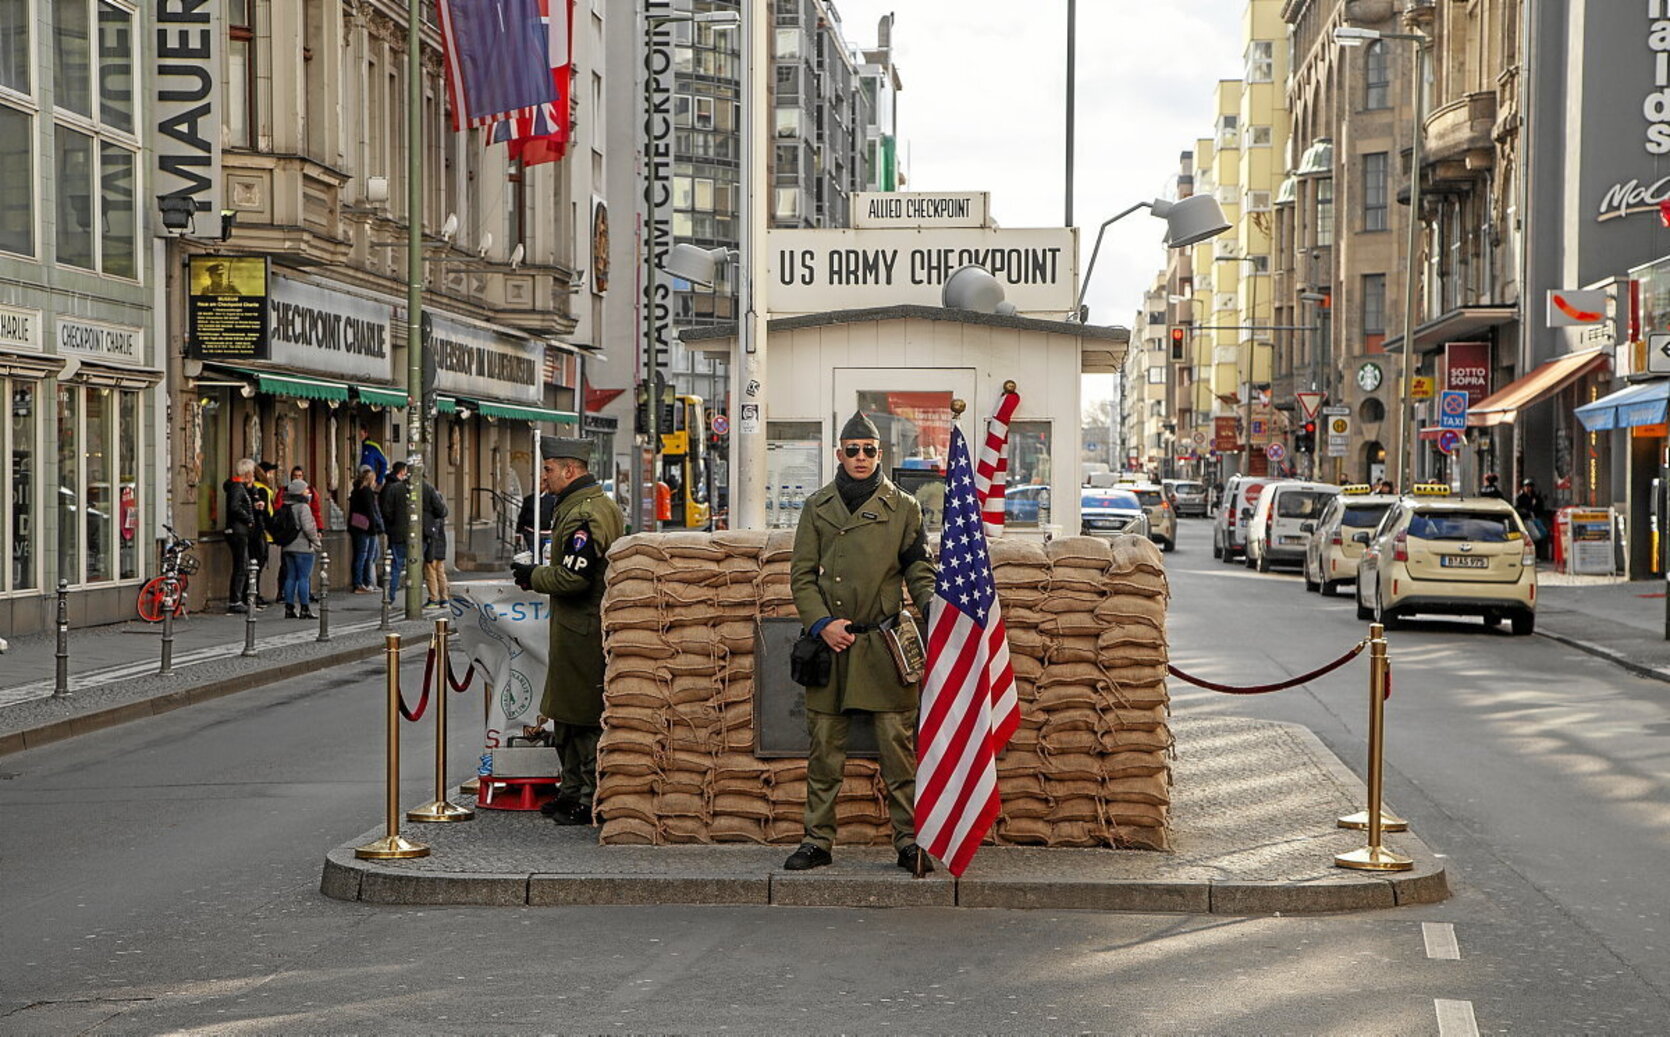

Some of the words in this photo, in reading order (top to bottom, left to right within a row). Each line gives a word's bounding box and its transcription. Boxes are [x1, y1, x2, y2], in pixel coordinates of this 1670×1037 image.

[643, 0, 671, 208] CHECKPOINT
[868, 198, 902, 219] ALLIED
[907, 198, 971, 219] CHECKPOINT
[643, 219, 670, 271] AM
[828, 249, 898, 286] ARMY
[0, 313, 29, 342] HARLIE
[62, 323, 104, 352] CHECKPOINT
[106, 330, 133, 356] CHARLIE
[270, 299, 342, 351] CHECKPOINT
[344, 315, 386, 359] CHARLIE
[643, 283, 670, 368] HAUS
[1450, 367, 1486, 377] SOTTO
[1450, 377, 1486, 386] SOPRA
[1442, 416, 1464, 427] TAXI
[562, 554, 588, 571] MP
